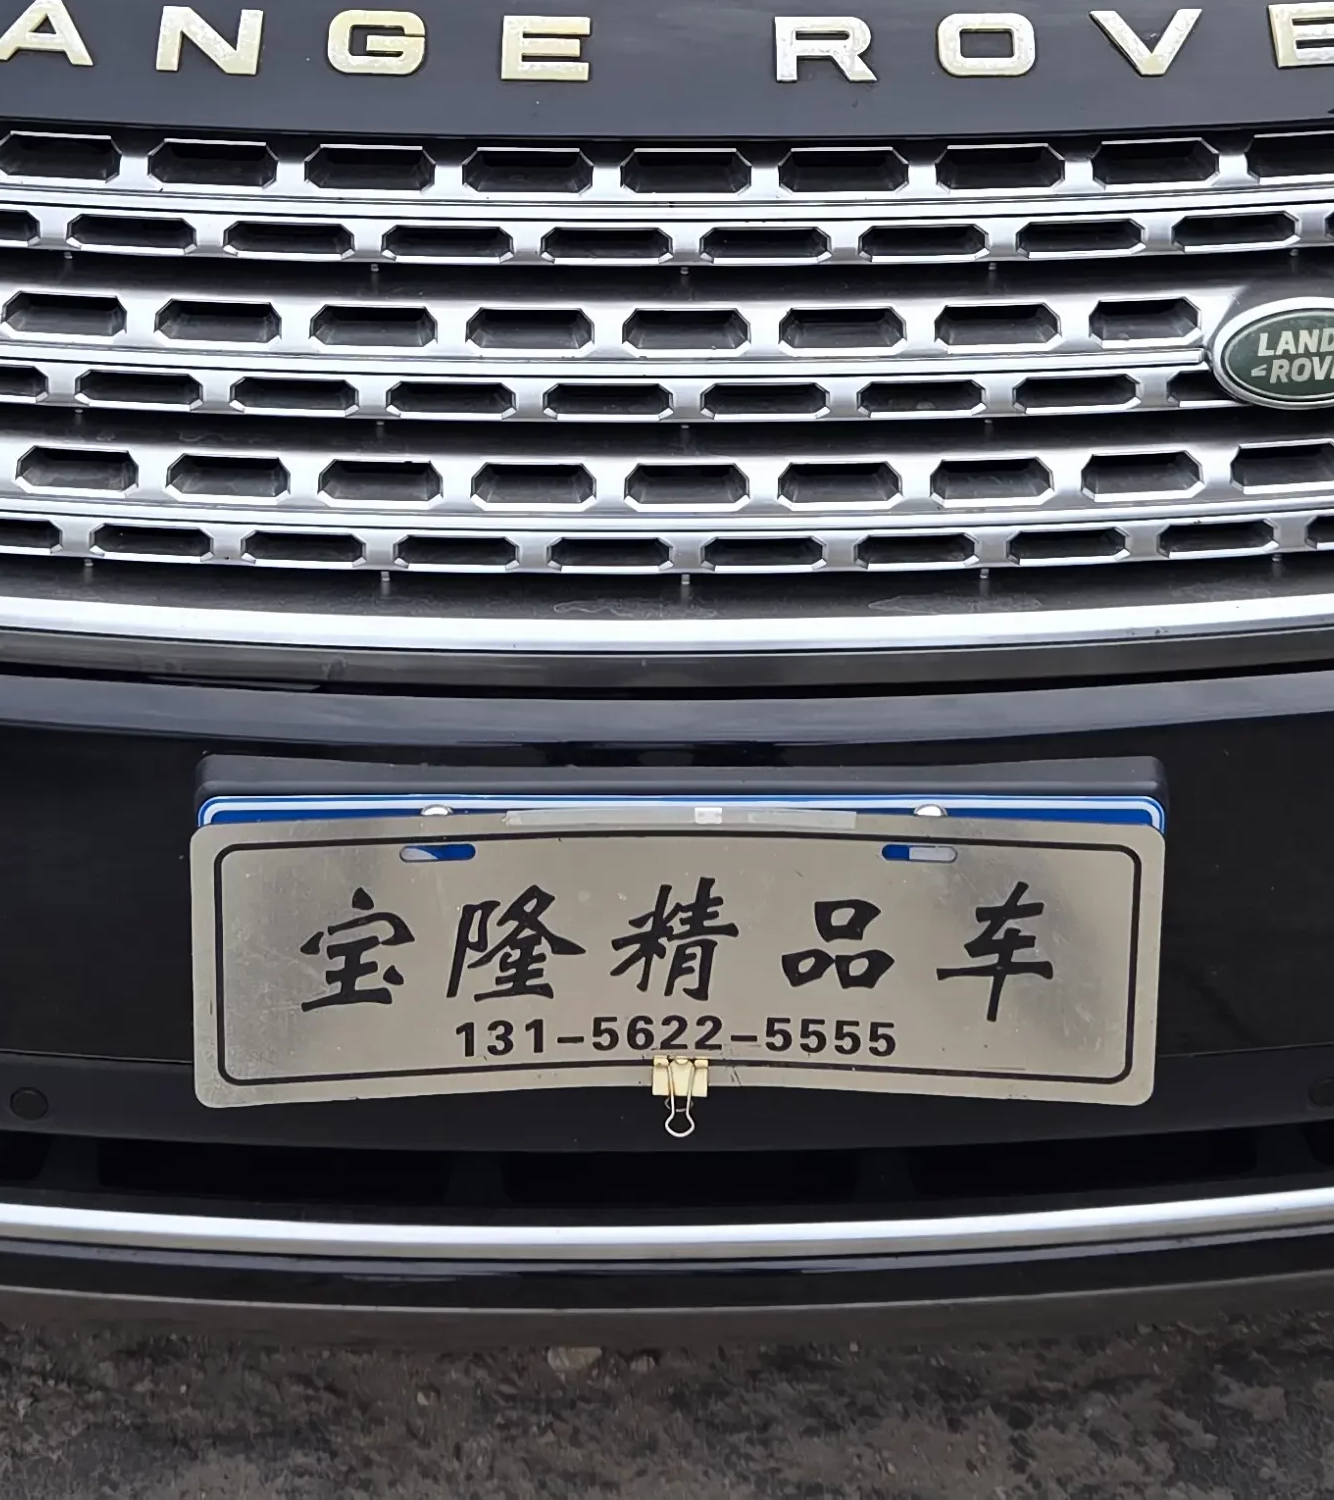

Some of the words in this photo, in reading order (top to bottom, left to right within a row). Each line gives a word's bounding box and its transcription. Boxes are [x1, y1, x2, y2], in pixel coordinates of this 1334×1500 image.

[299, 876, 1055, 1023] 宝隆精品车
[455, 1014, 897, 1057] 131-5622-5555
